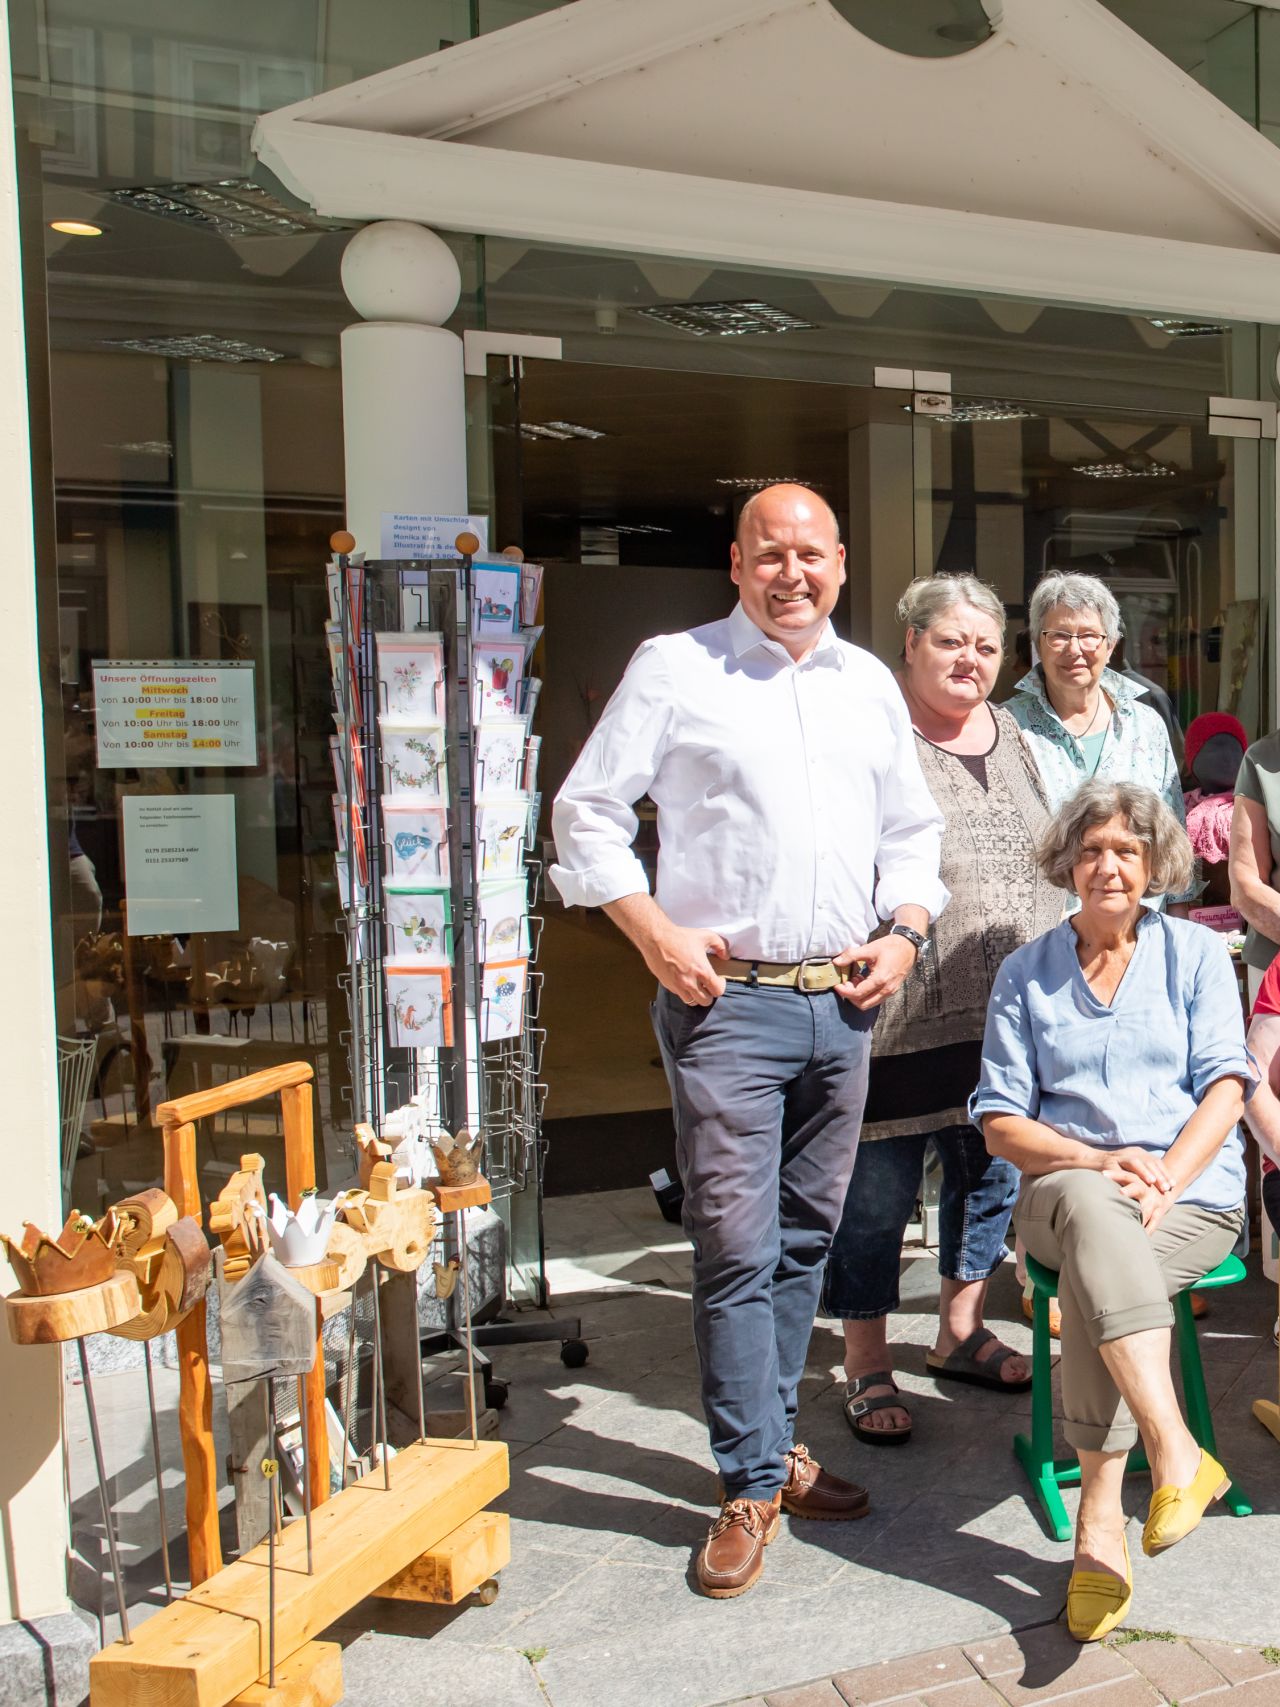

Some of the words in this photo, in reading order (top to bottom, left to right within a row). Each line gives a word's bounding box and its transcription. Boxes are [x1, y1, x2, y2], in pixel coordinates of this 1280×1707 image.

[434, 516, 469, 525] Umschlag
[100, 675, 137, 683] Unsere
[140, 674, 217, 684] Öffnungszeiten
[141, 686, 189, 694] Mittwoch
[122, 696, 151, 704] 10:00
[154, 696, 172, 704] Uhr
[174, 696, 187, 704] bis
[190, 696, 219, 704] 18:00
[221, 696, 238, 704] Uhr
[149, 709, 186, 719] Freitag
[102, 720, 120, 728] Von
[124, 719, 153, 727] 10:00
[156, 719, 173, 727] Uhr
[176, 719, 189, 727] bis
[192, 719, 220, 727] 18:00
[223, 719, 240, 727] Uhr
[143, 730, 188, 740] Samstag
[103, 741, 121, 749] Von
[125, 741, 154, 749] 10:00
[157, 740, 174, 748] Uhr
[176, 740, 190, 748] bis
[192, 740, 221, 748] 14:00
[224, 740, 241, 748] Uhr
